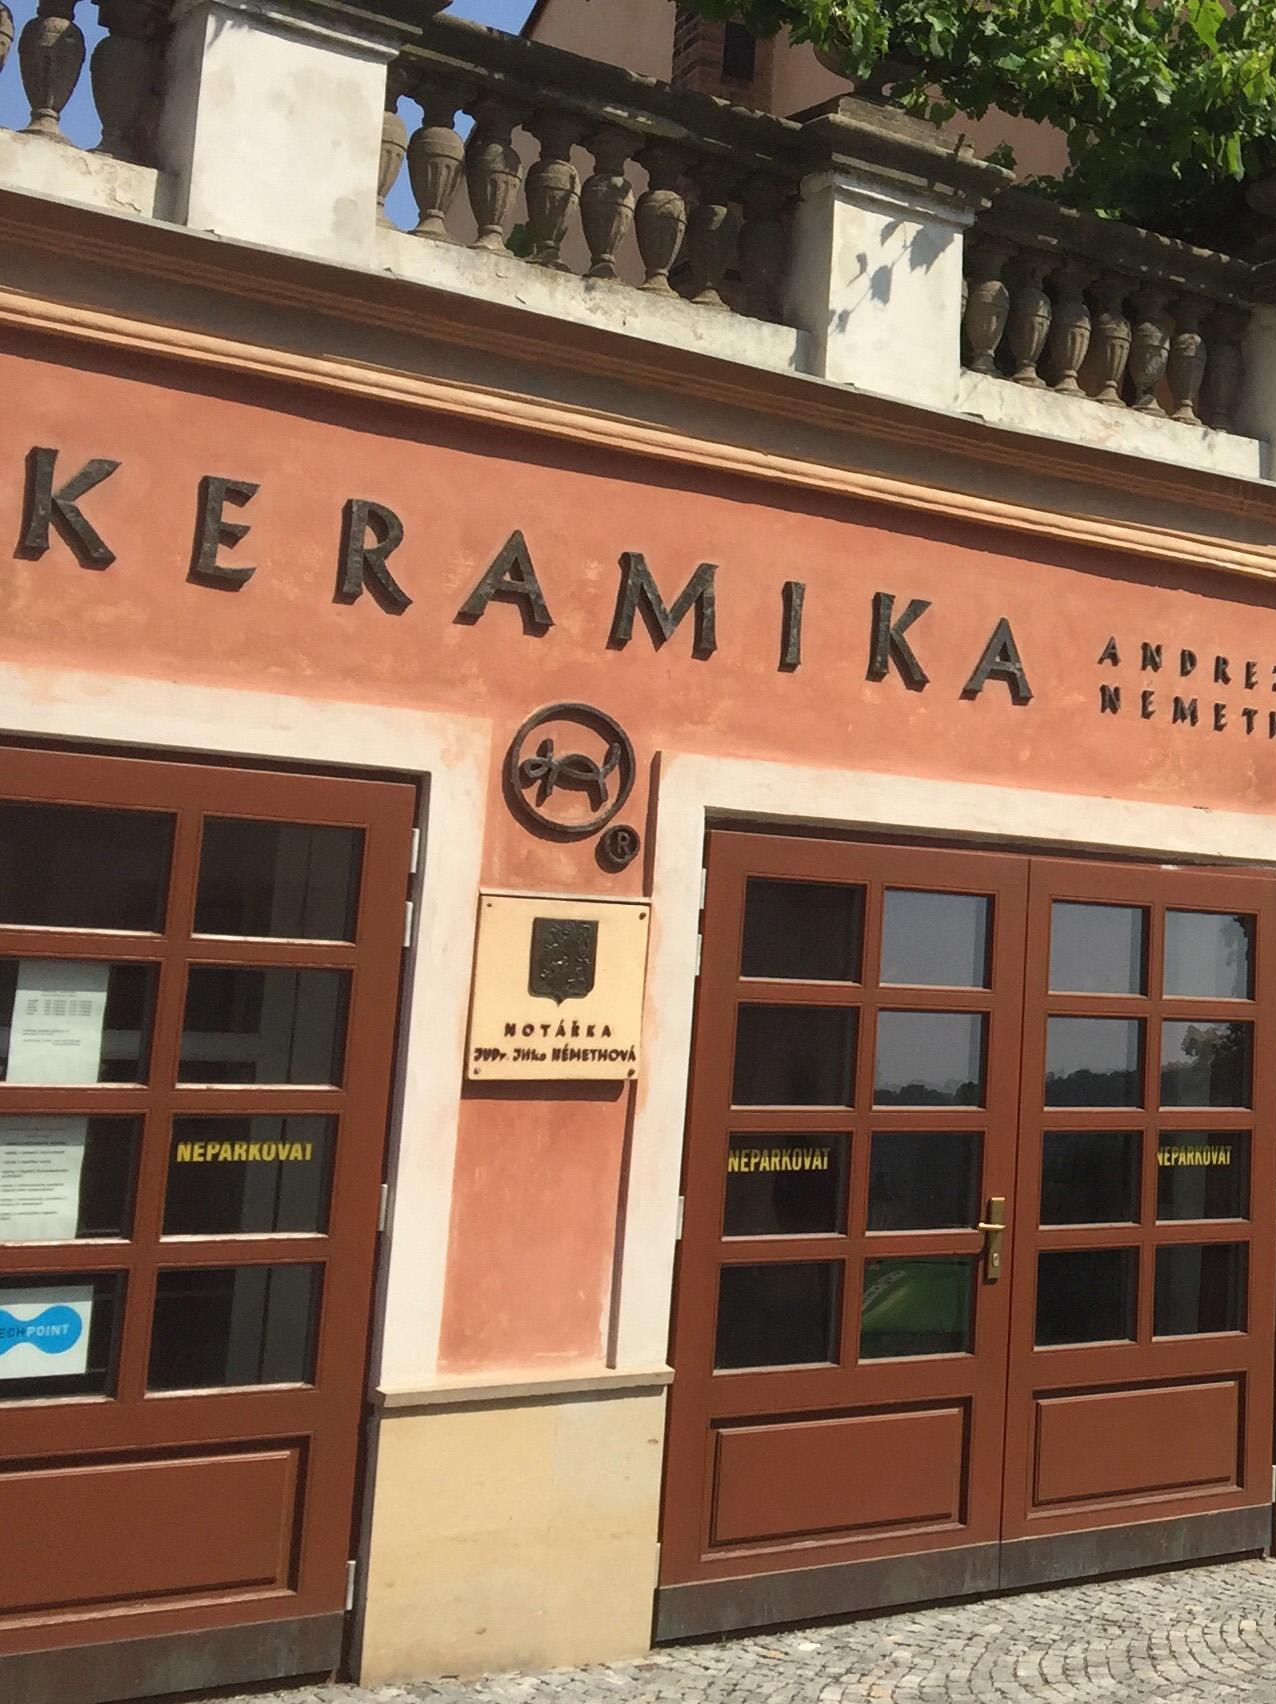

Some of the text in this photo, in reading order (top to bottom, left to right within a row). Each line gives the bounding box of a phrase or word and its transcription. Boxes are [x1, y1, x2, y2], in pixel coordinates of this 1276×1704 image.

[13, 446, 1033, 706] KERAMIKA
[503, 1019, 612, 1038] NOTÁŘKA
[727, 1148, 832, 1173] NEPARKOVAT
